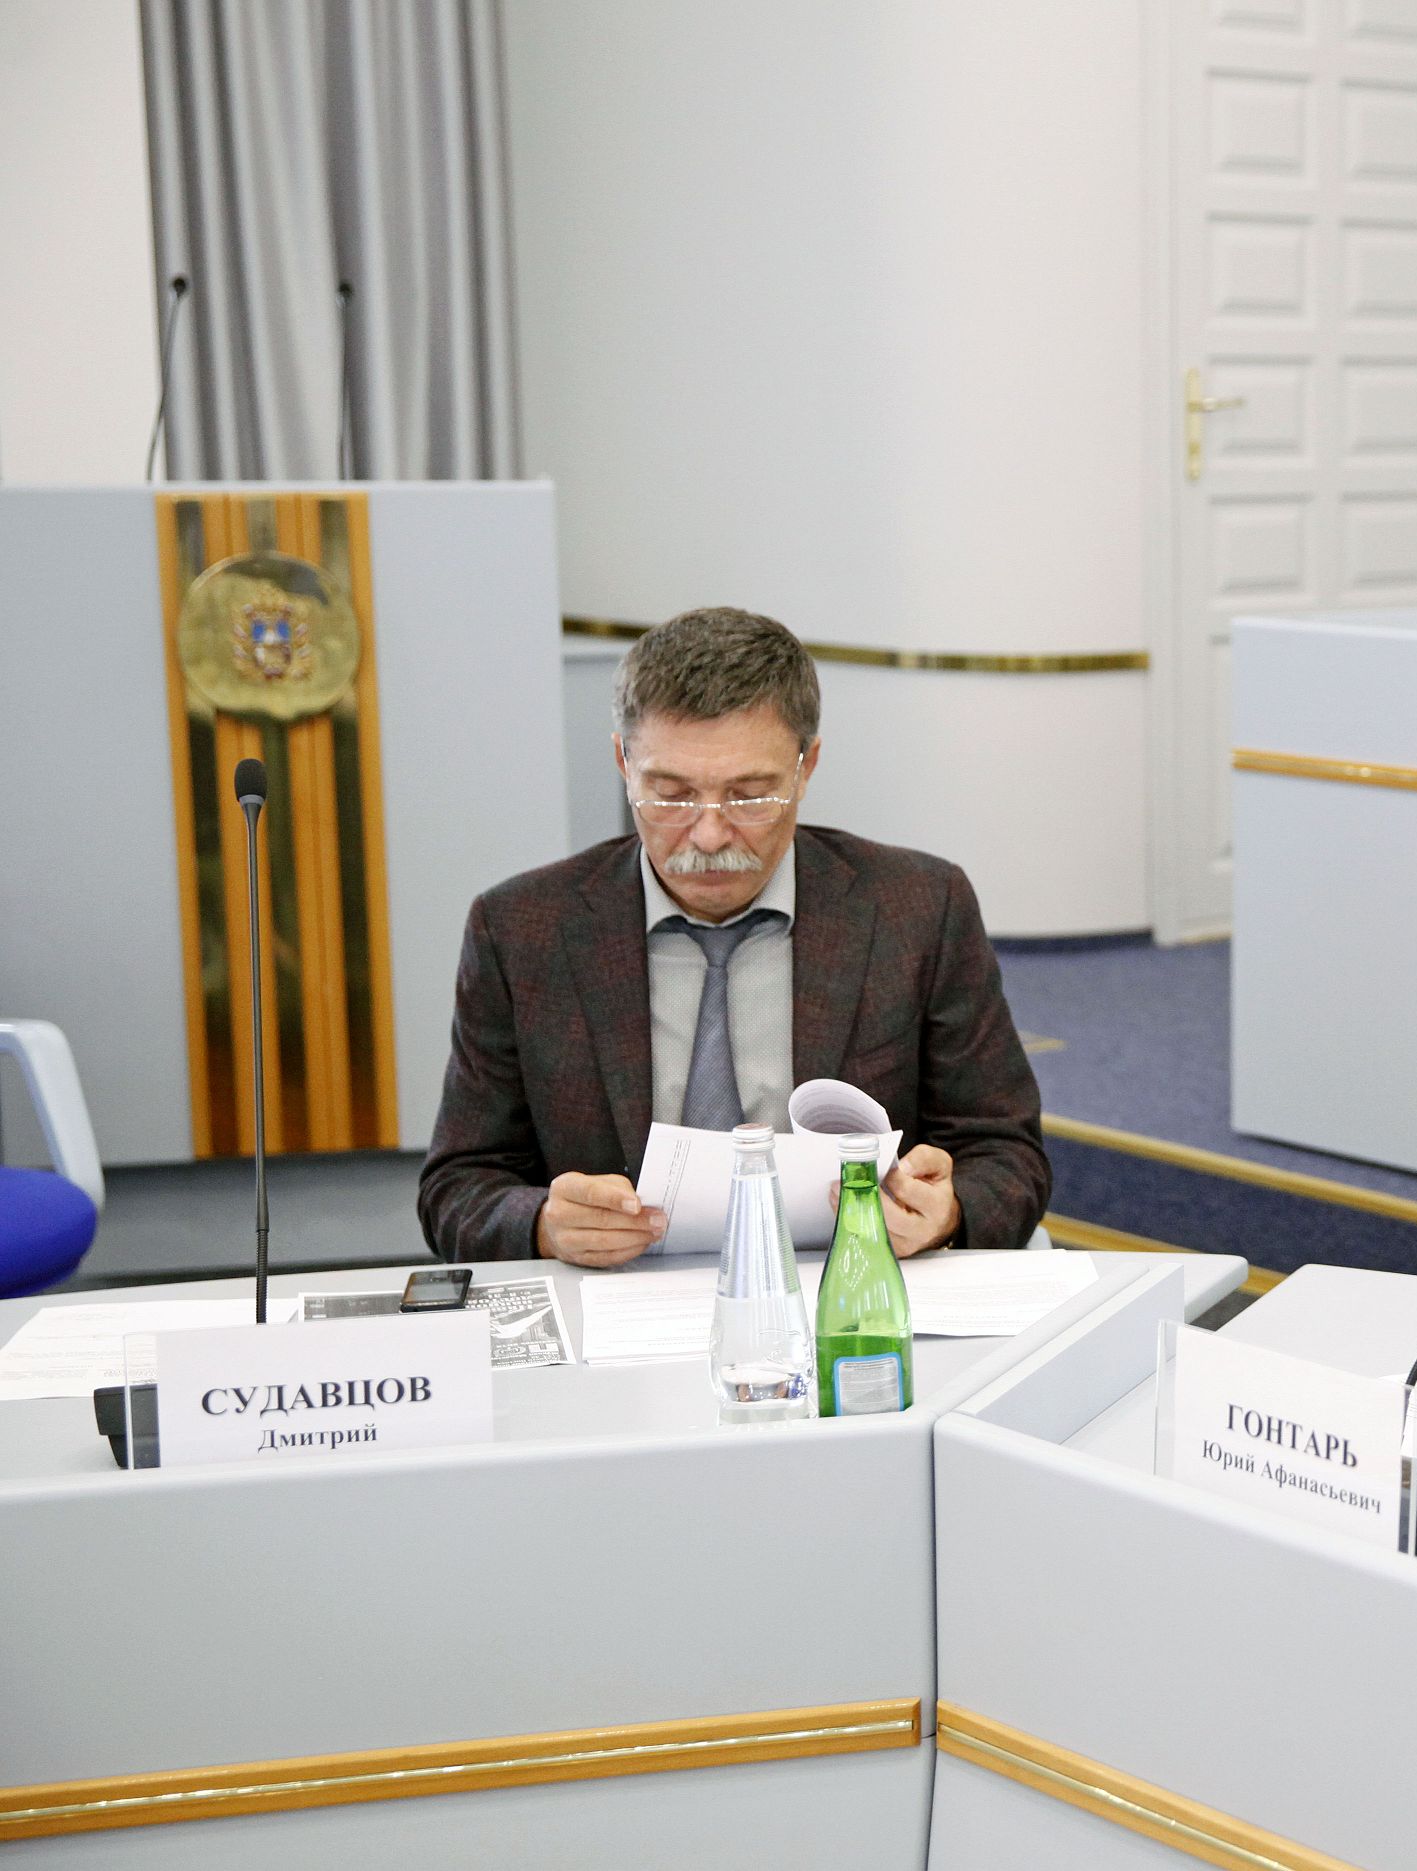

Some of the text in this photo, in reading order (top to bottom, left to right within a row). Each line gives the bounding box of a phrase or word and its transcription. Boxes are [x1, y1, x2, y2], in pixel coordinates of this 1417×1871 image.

[201, 1375, 433, 1418] СУДАВЦОВ
[257, 1422, 378, 1453] Дмитрий
[1225, 1402, 1359, 1470] ГОНТАРЬ
[1202, 1438, 1382, 1516] Юрий Афанасьевич
